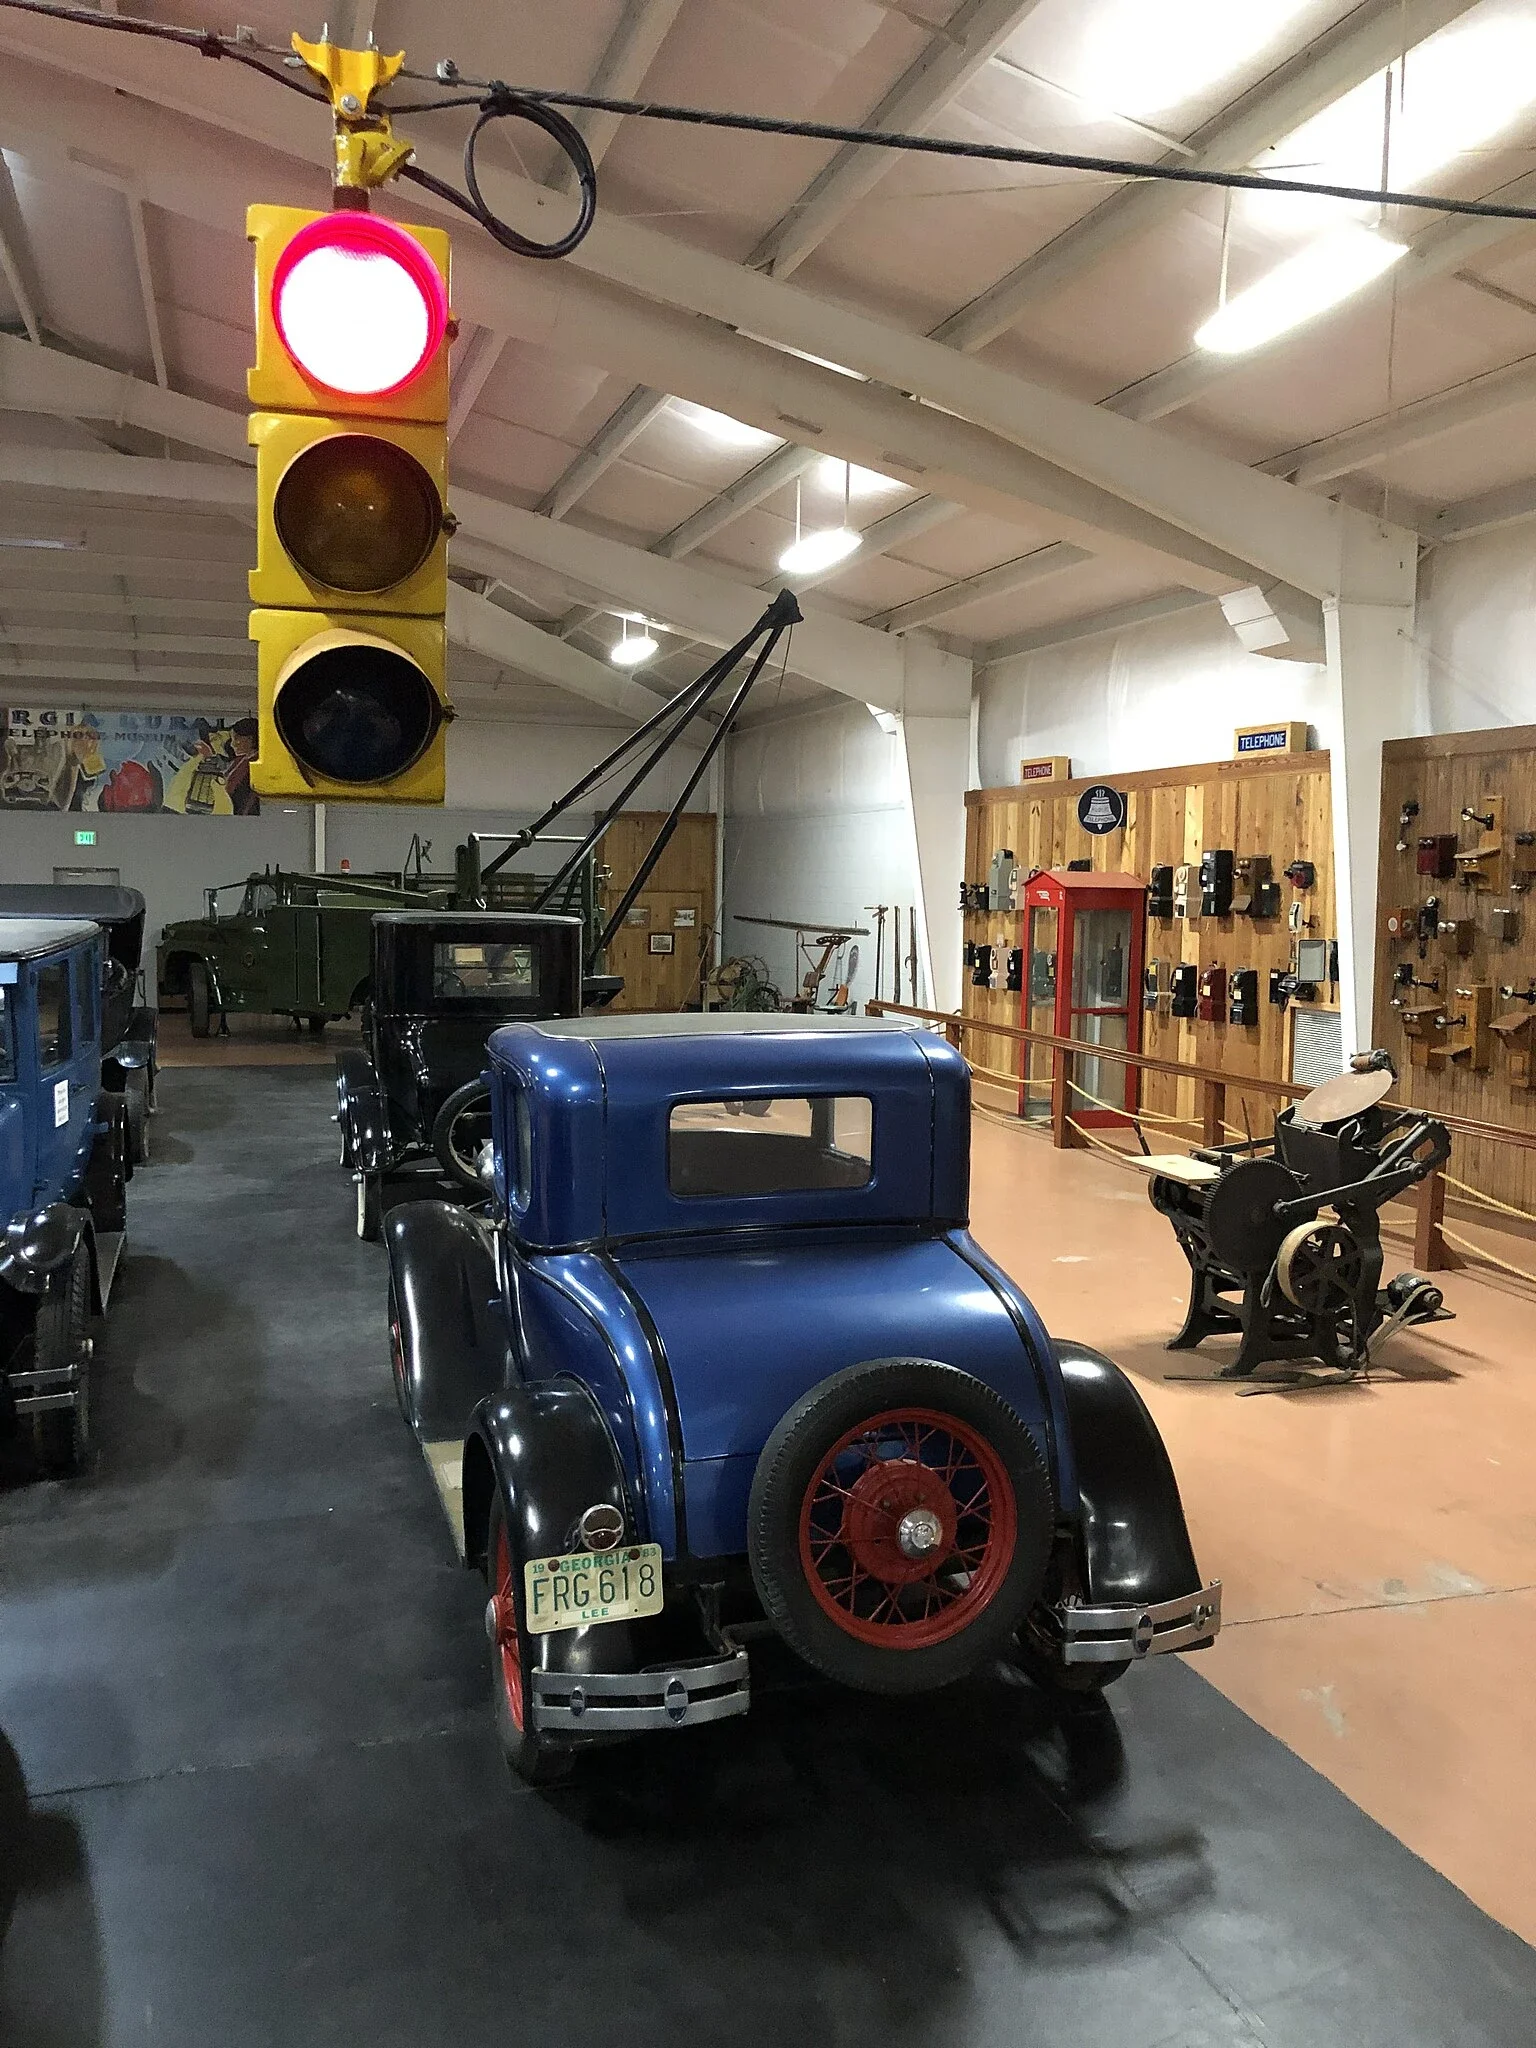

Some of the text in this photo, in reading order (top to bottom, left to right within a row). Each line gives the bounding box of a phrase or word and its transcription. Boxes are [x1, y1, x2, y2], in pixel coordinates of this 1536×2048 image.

[114, 732, 177, 742] MUSEUM
[1240, 733, 1286, 750] TELEPHONE
[1024, 764, 1052, 778] TELEPHONE
[78, 832, 95, 844] EXIT
[532, 1563, 545, 1575] 19
[559, 1551, 631, 1573] GEORGIA
[532, 1563, 655, 1615] FRG 618
[581, 1607, 609, 1619] LEE
